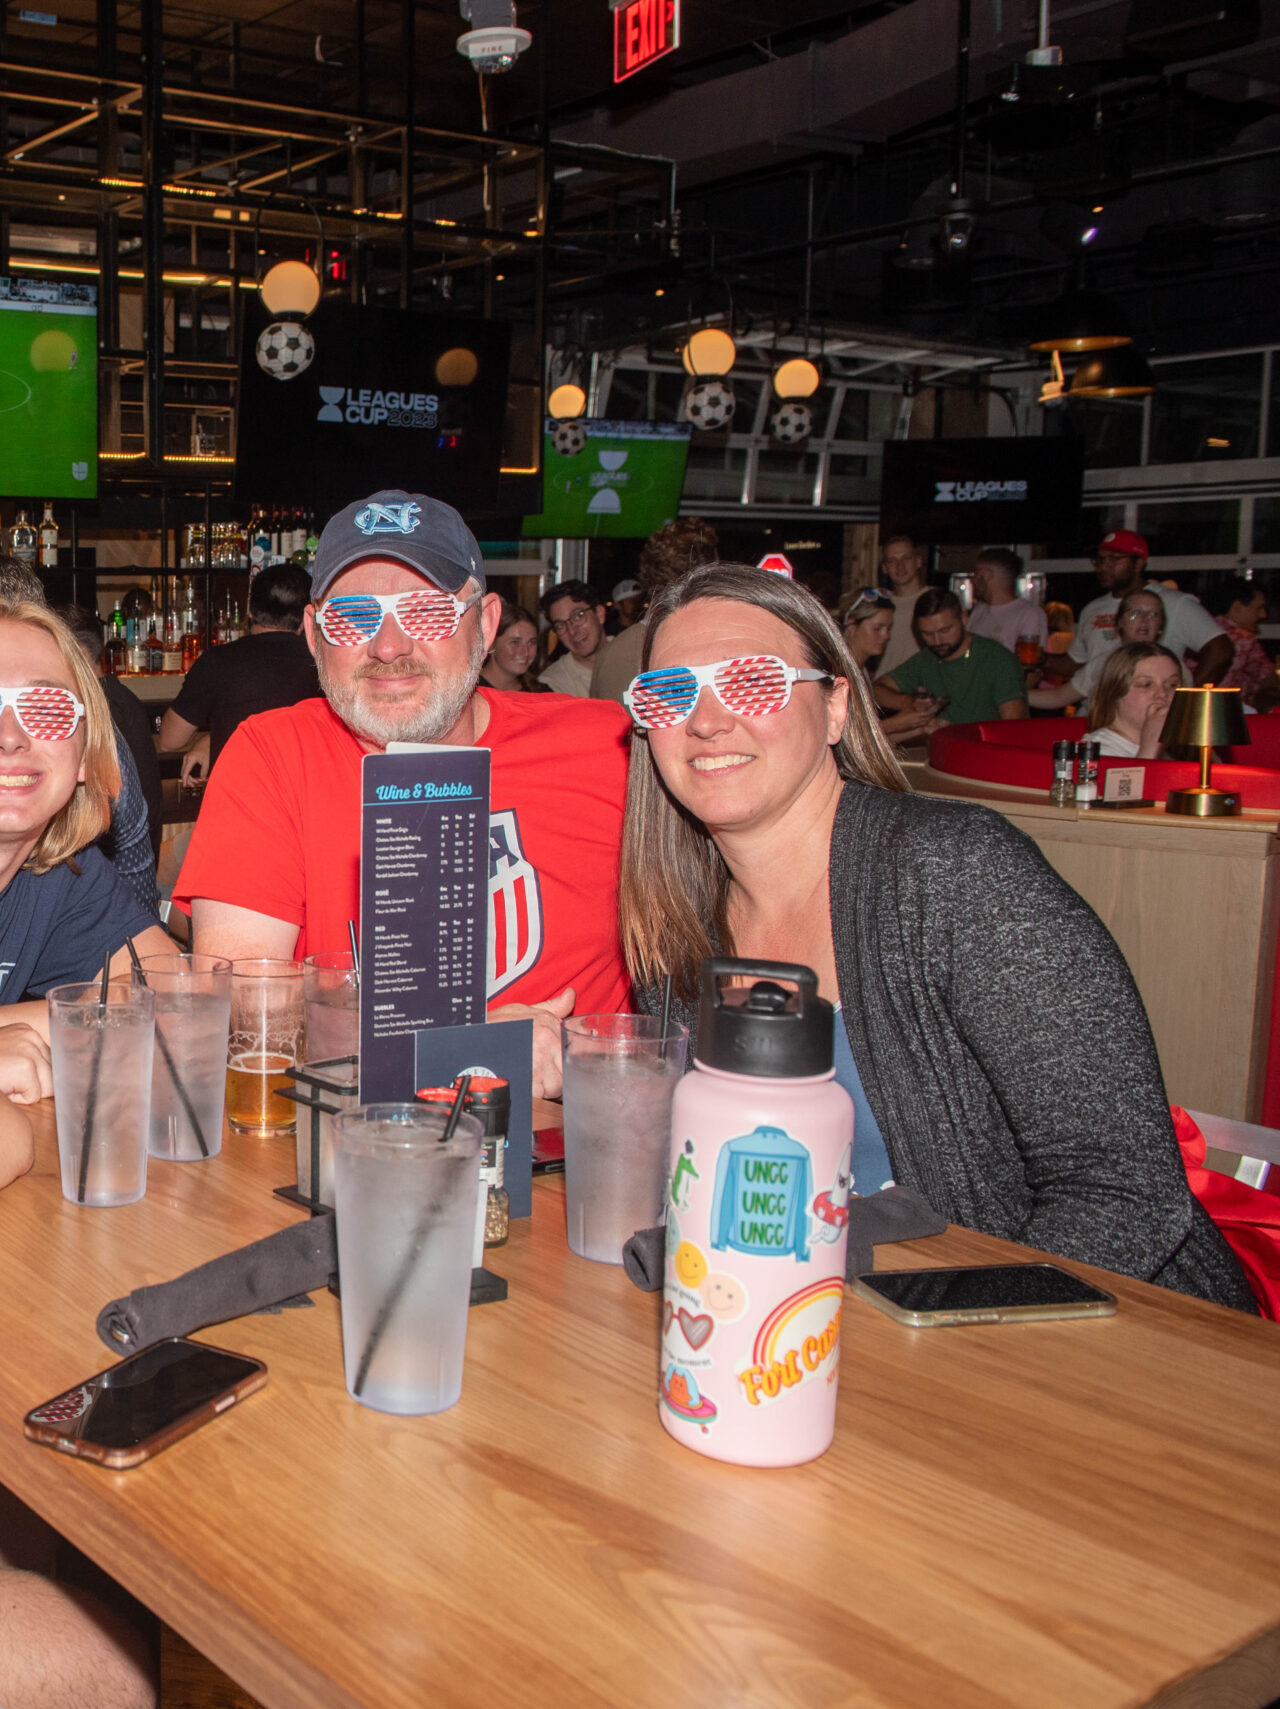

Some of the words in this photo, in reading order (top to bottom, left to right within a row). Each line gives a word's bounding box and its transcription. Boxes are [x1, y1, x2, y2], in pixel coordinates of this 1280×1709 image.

[626, 0, 666, 70] EXIT
[346, 388, 439, 412] LEAGUES
[345, 406, 388, 425] CUP
[387, 409, 438, 429] 2023
[956, 480, 1027, 492] LEAGUES
[956, 490, 988, 501] CUP
[376, 784, 411, 800] Wine
[412, 783, 422, 799] &
[423, 782, 473, 798] Bubbles
[744, 1159, 789, 1185] UNCC
[742, 1190, 787, 1216] UNCC
[740, 1220, 785, 1246] UNCC
[738, 1349, 803, 1406] Fort
